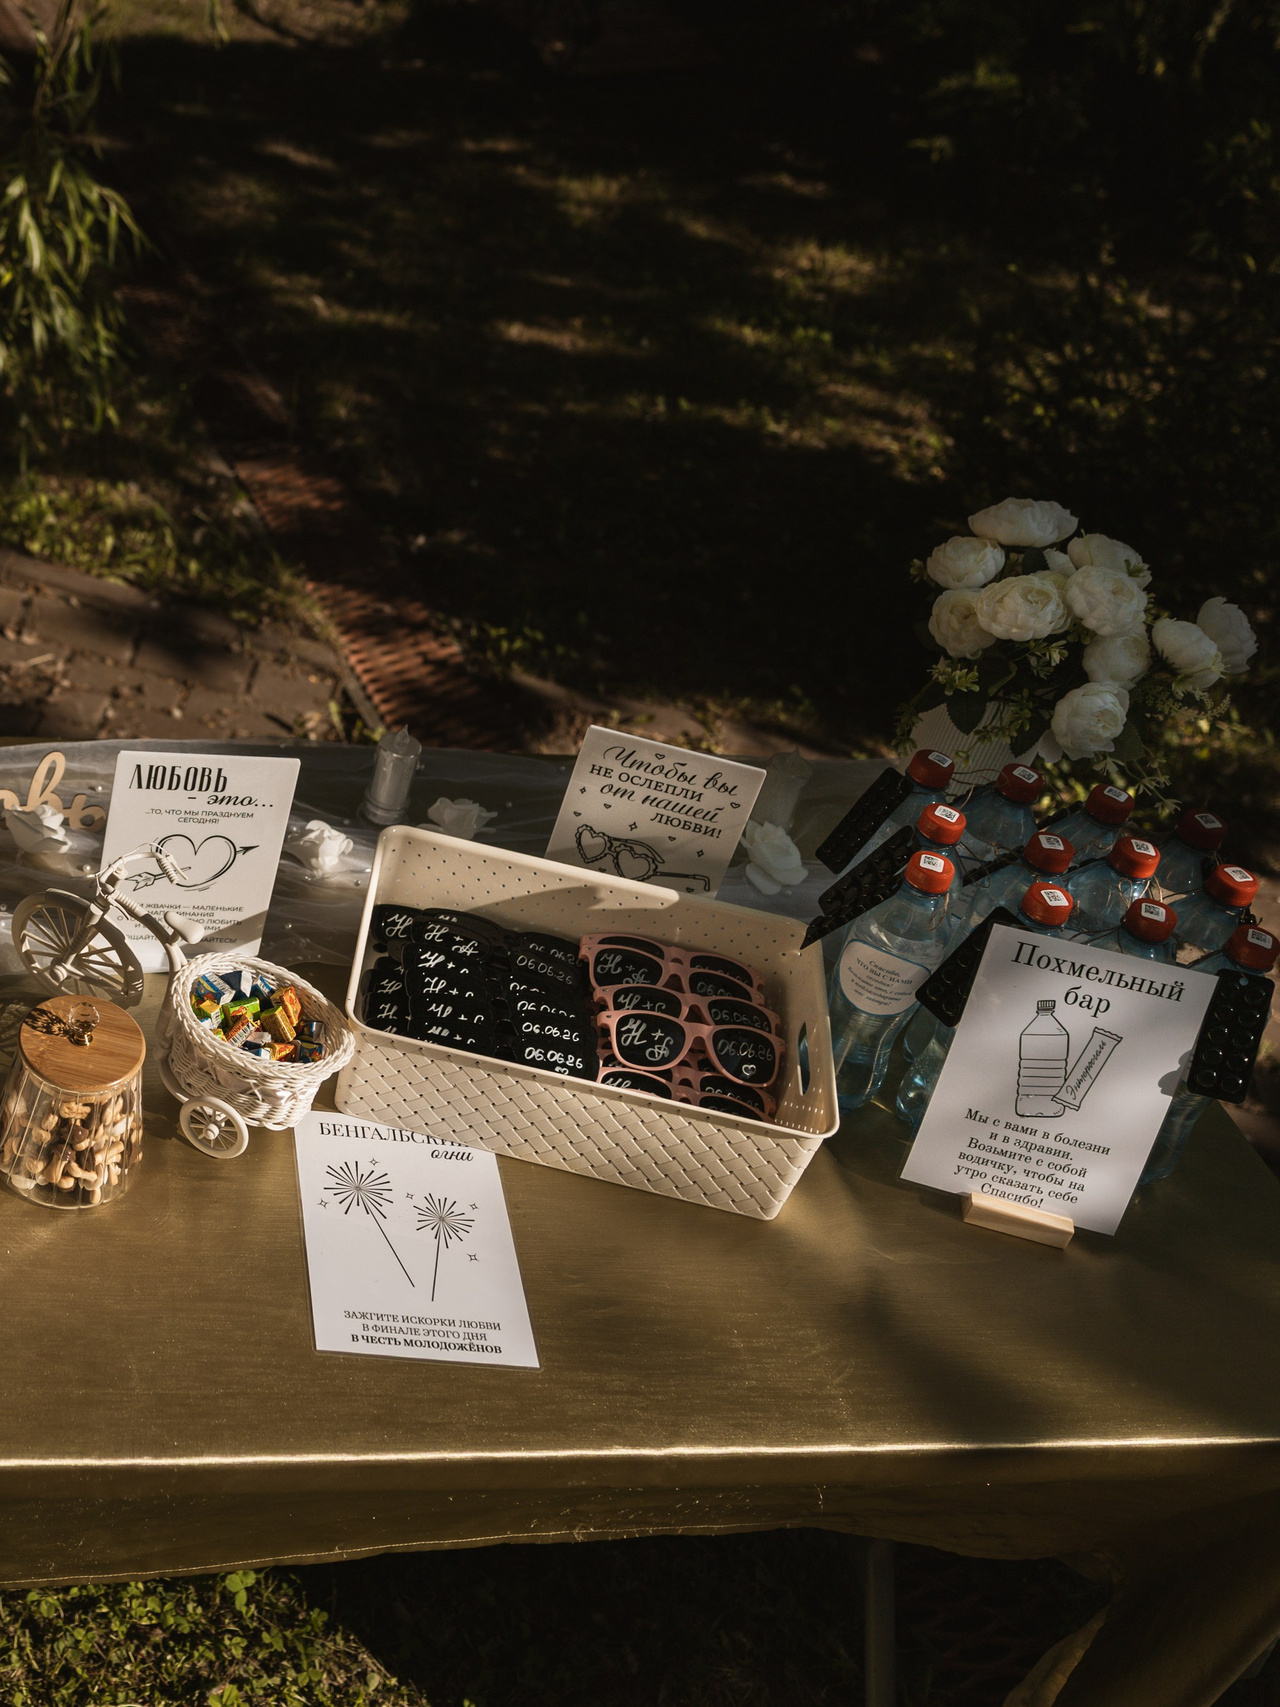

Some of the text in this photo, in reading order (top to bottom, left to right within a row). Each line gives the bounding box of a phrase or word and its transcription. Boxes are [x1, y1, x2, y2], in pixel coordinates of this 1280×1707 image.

[128, 763, 228, 793] ЛЮБОВЬ
[589, 763, 704, 803] НЕ ОСЛЕПЛИ
[603, 745, 740, 797] Чтобы вы
[206, 794, 274, 808] это...
[600, 782, 725, 824] от нашей
[178, 816, 220, 825] СЕГОДНЯ!
[201, 810, 254, 819] ПРАЗДНУЕМ
[650, 812, 722, 840] ЛЮБВИ!
[148, 910, 215, 918] НАПИНАНИЯ
[206, 918, 242, 926] ЛЮБИТЬ
[856, 957, 869, 970] ЧТО
[869, 968, 881, 978] ВЫ
[889, 976, 913, 985] НАМИ
[869, 960, 901, 978] Спасибо,
[1011, 940, 1186, 1002] Похмельный
[1064, 985, 1111, 1019] бар
[522, 1021, 580, 1042] 06.06.26
[717, 1038, 774, 1061] 06.06.26
[319, 1122, 470, 1148] БЕНГАЛЬСК
[965, 1108, 1111, 1156] Мы с вами в болезни
[430, 1148, 474, 1162] огни
[967, 1137, 1088, 1180] Возьмите с собой
[989, 1132, 1073, 1161] и в здравии.
[953, 1165, 1079, 1204] утро сказать себе
[958, 1152, 1085, 1192] водичку, чтобы на
[980, 1183, 1044, 1209] Спасибо!
[344, 1310, 501, 1331] ЗАЖГИТЕ ИСКОРКИ ЛЮБВИ
[362, 1323, 487, 1342] В ФИНАЛЕ ЭТОГО ДНЯ
[351, 1334, 502, 1354] В ЧЕСТЬ МОЛОДОЖЁНОВ
